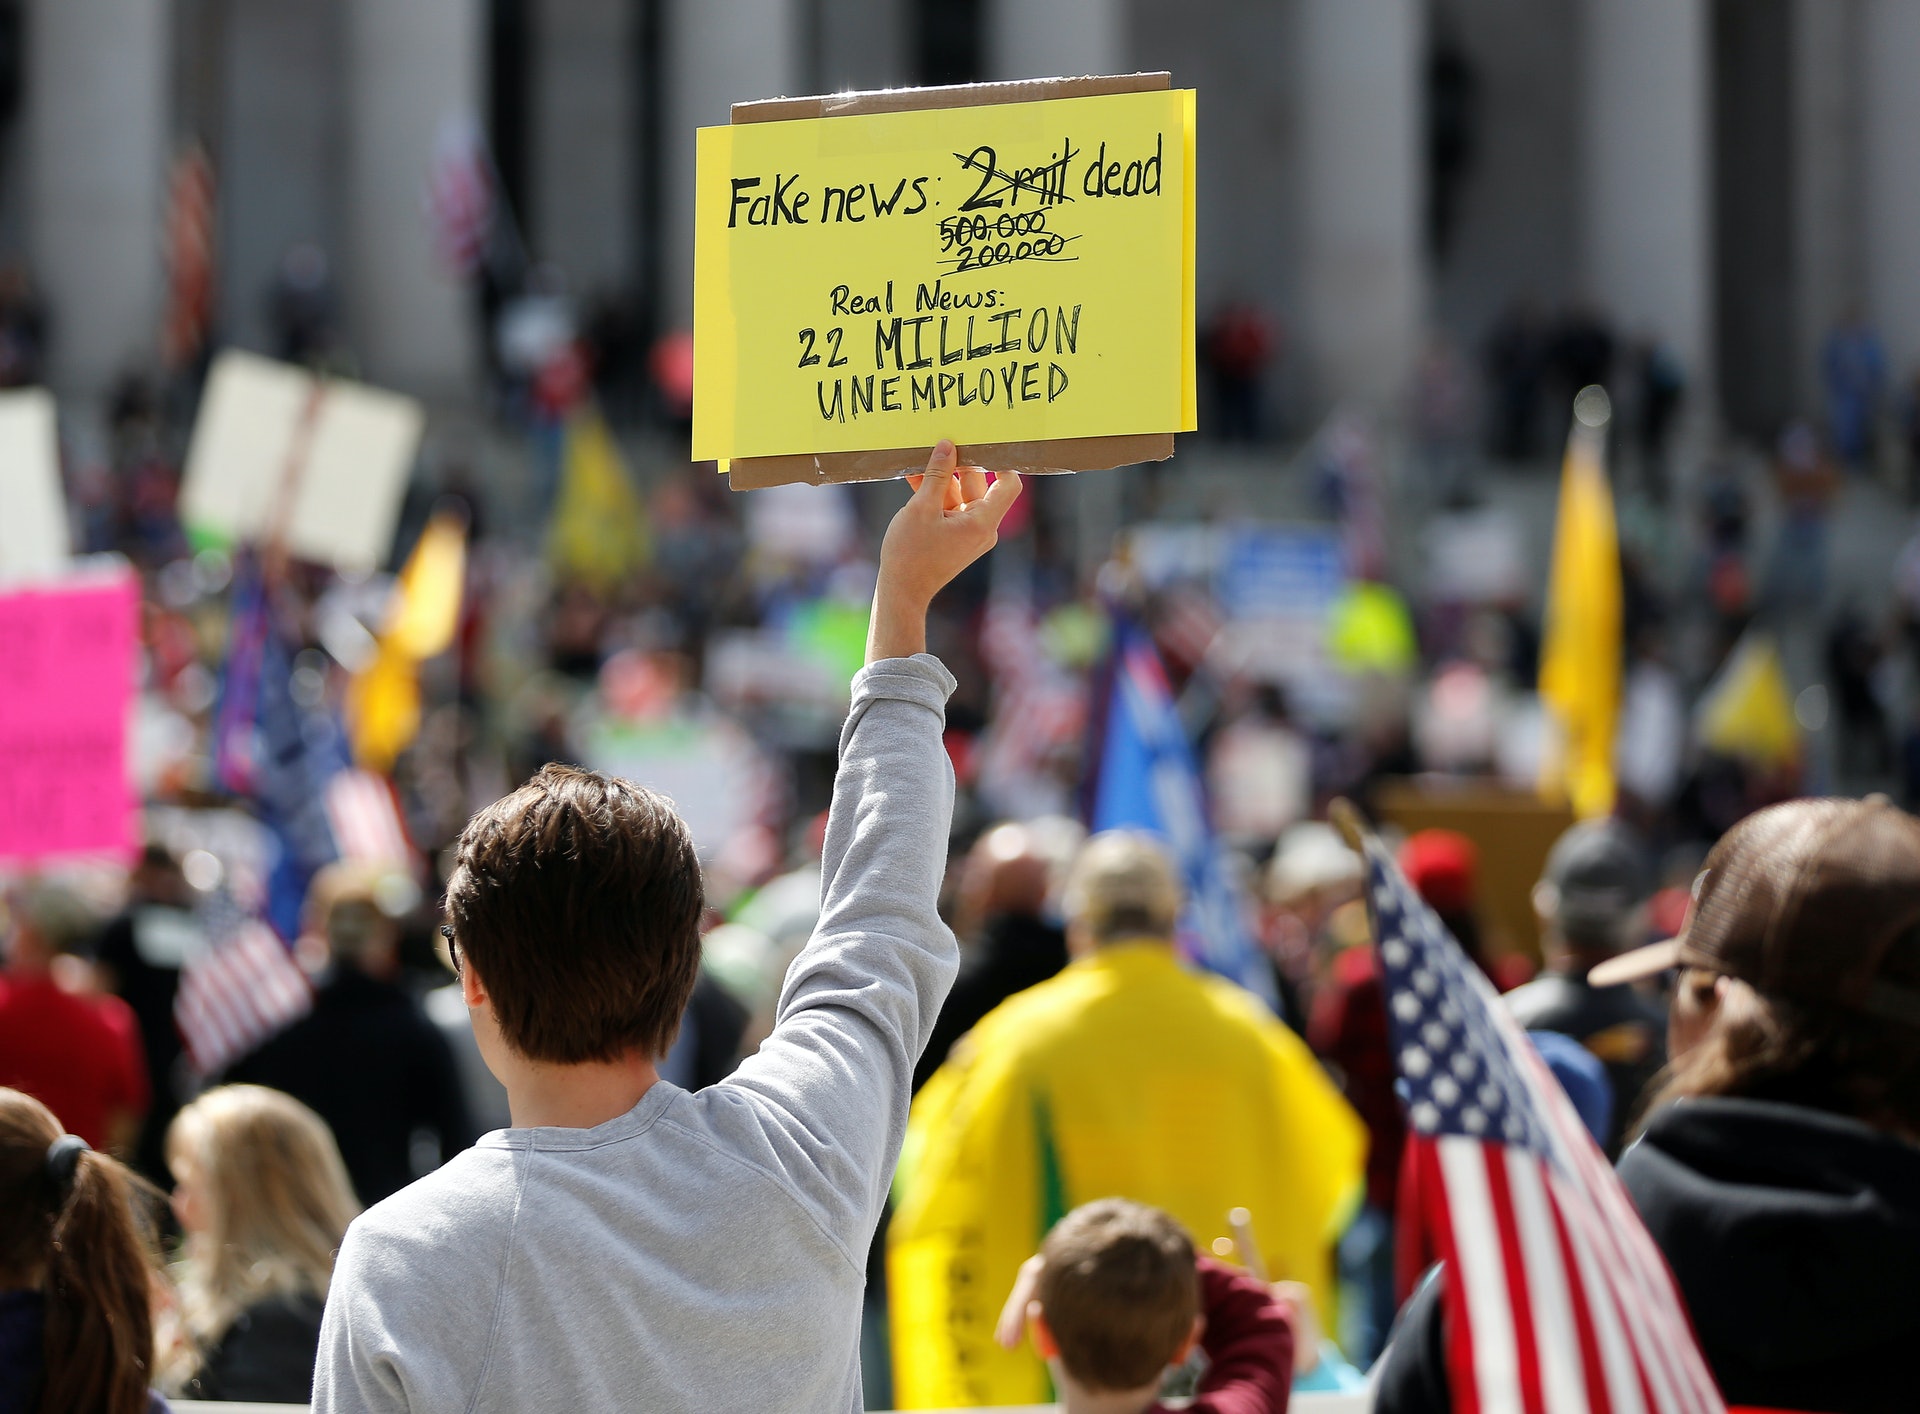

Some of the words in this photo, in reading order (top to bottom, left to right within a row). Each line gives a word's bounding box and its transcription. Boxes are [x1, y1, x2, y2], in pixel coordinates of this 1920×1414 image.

[820, 176, 941, 224] news:
[957, 145, 1003, 212] 2
[1083, 132, 1162, 199] dead
[940, 210, 1046, 252] 500,000
[956, 233, 1065, 272] 200,000
[830, 280, 893, 316] Real
[916, 279, 1005, 312] News:
[798, 327, 848, 369] 22
[876, 304, 1082, 371] MILLION
[817, 361, 1069, 424] UNEMPLOYED
